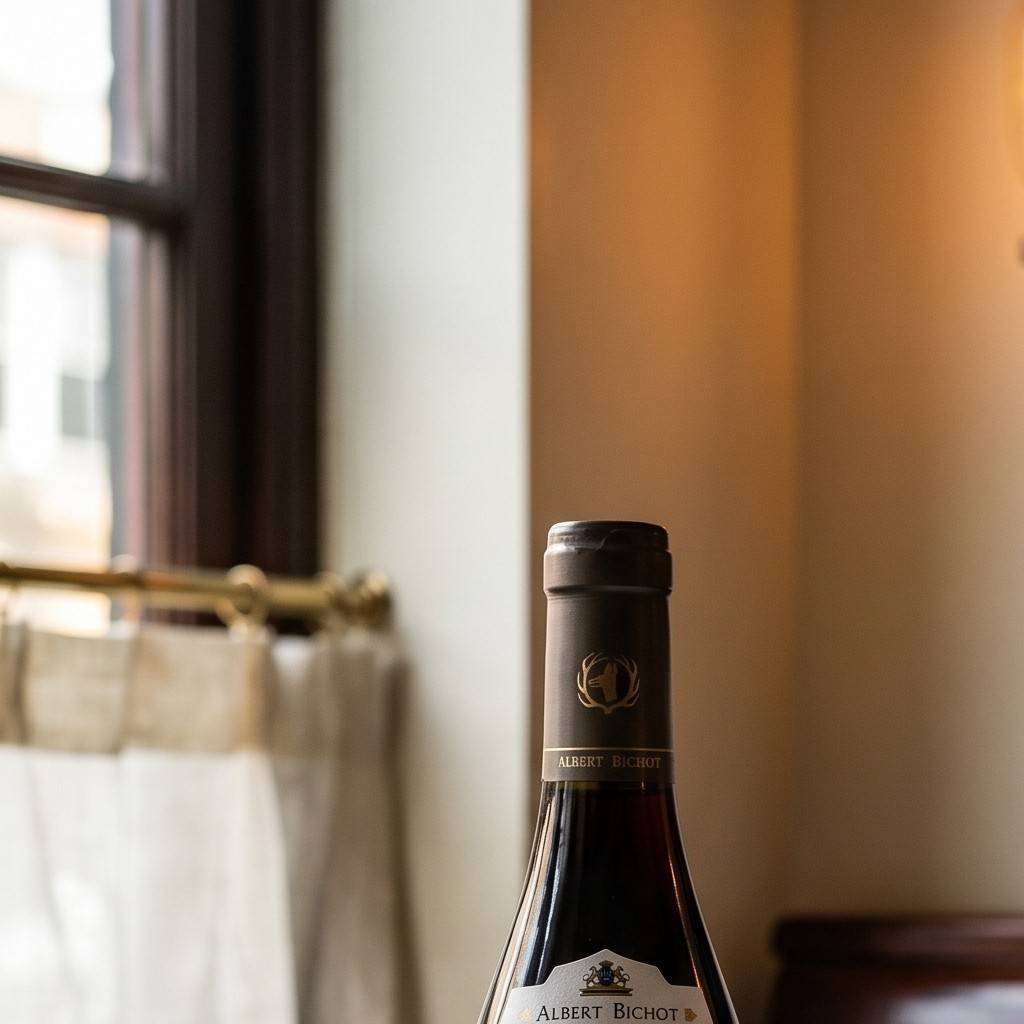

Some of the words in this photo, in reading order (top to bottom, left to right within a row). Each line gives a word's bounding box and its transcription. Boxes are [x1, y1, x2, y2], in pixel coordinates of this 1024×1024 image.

[558, 755, 604, 768] ALBERT
[612, 756, 661, 768] BICHOT
[536, 1005, 603, 1021] ALBERT
[613, 1002, 678, 1021] BICHOT
